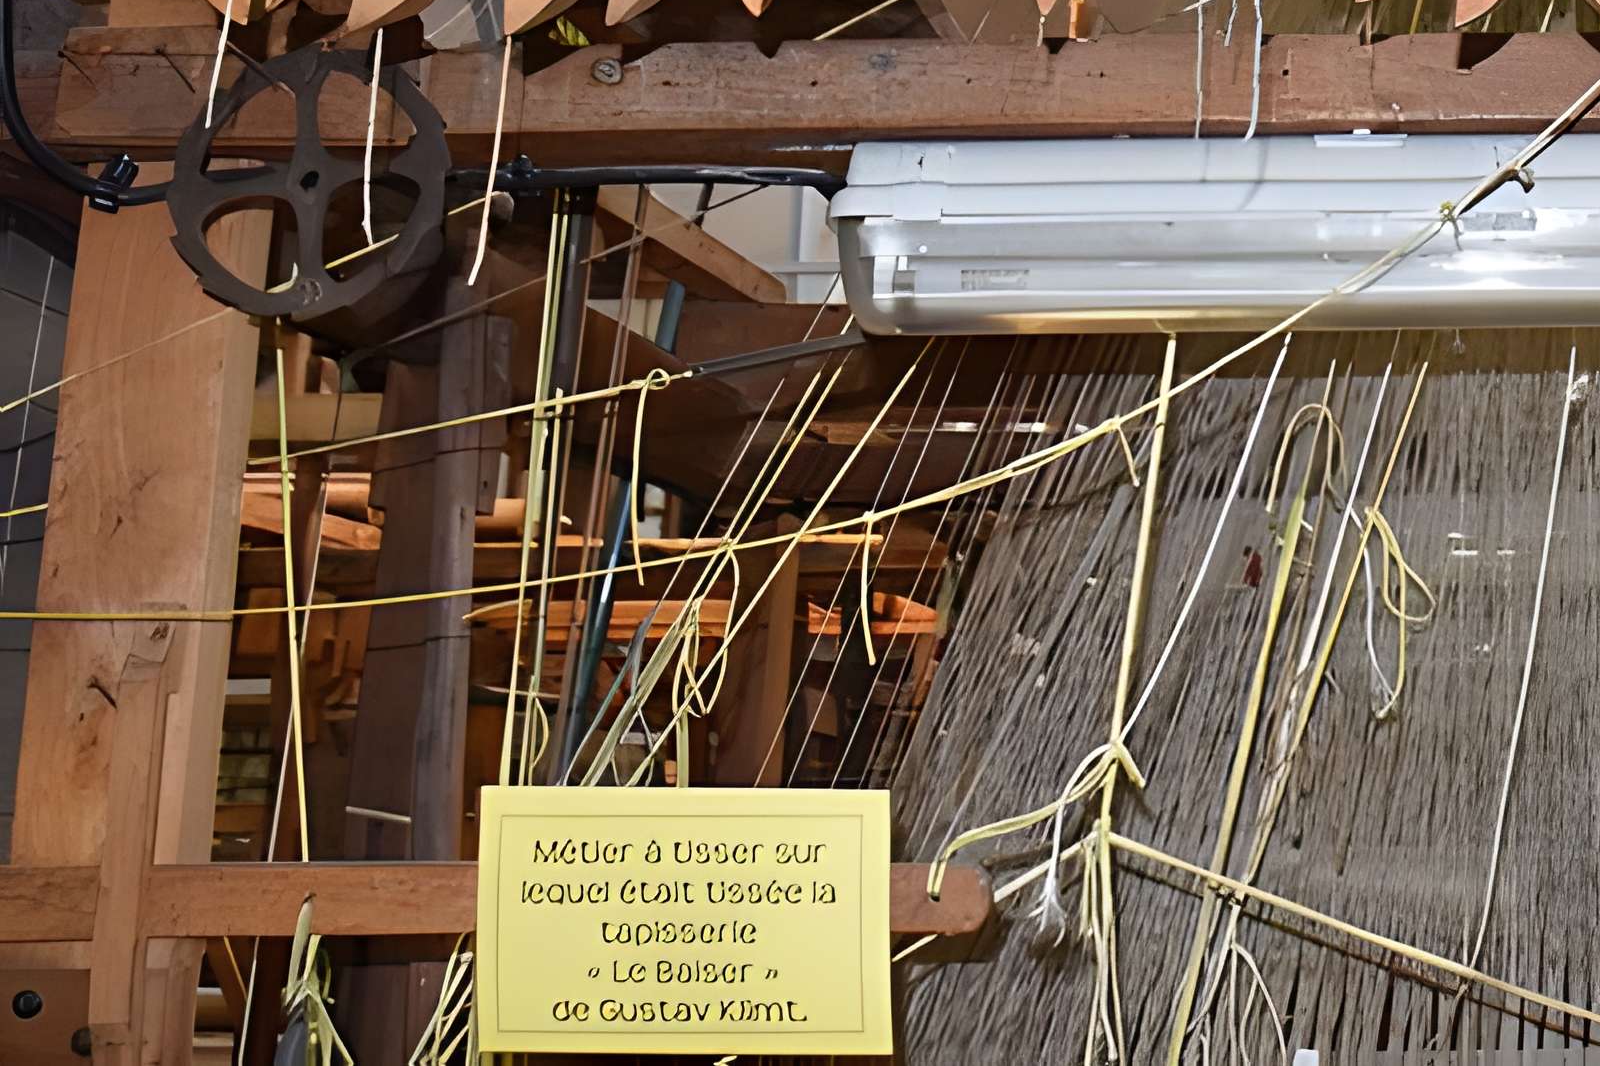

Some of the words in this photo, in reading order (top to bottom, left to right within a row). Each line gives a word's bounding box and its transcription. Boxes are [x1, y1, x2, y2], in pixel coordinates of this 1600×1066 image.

[775, 843, 828, 864] sur
[521, 879, 610, 906] lequel
[811, 880, 837, 904] la
[600, 919, 758, 947] tapisserie
[612, 959, 647, 984] Le
[655, 959, 754, 984] Baiser
[551, 999, 590, 1023] de
[599, 998, 712, 1023] Gustav
